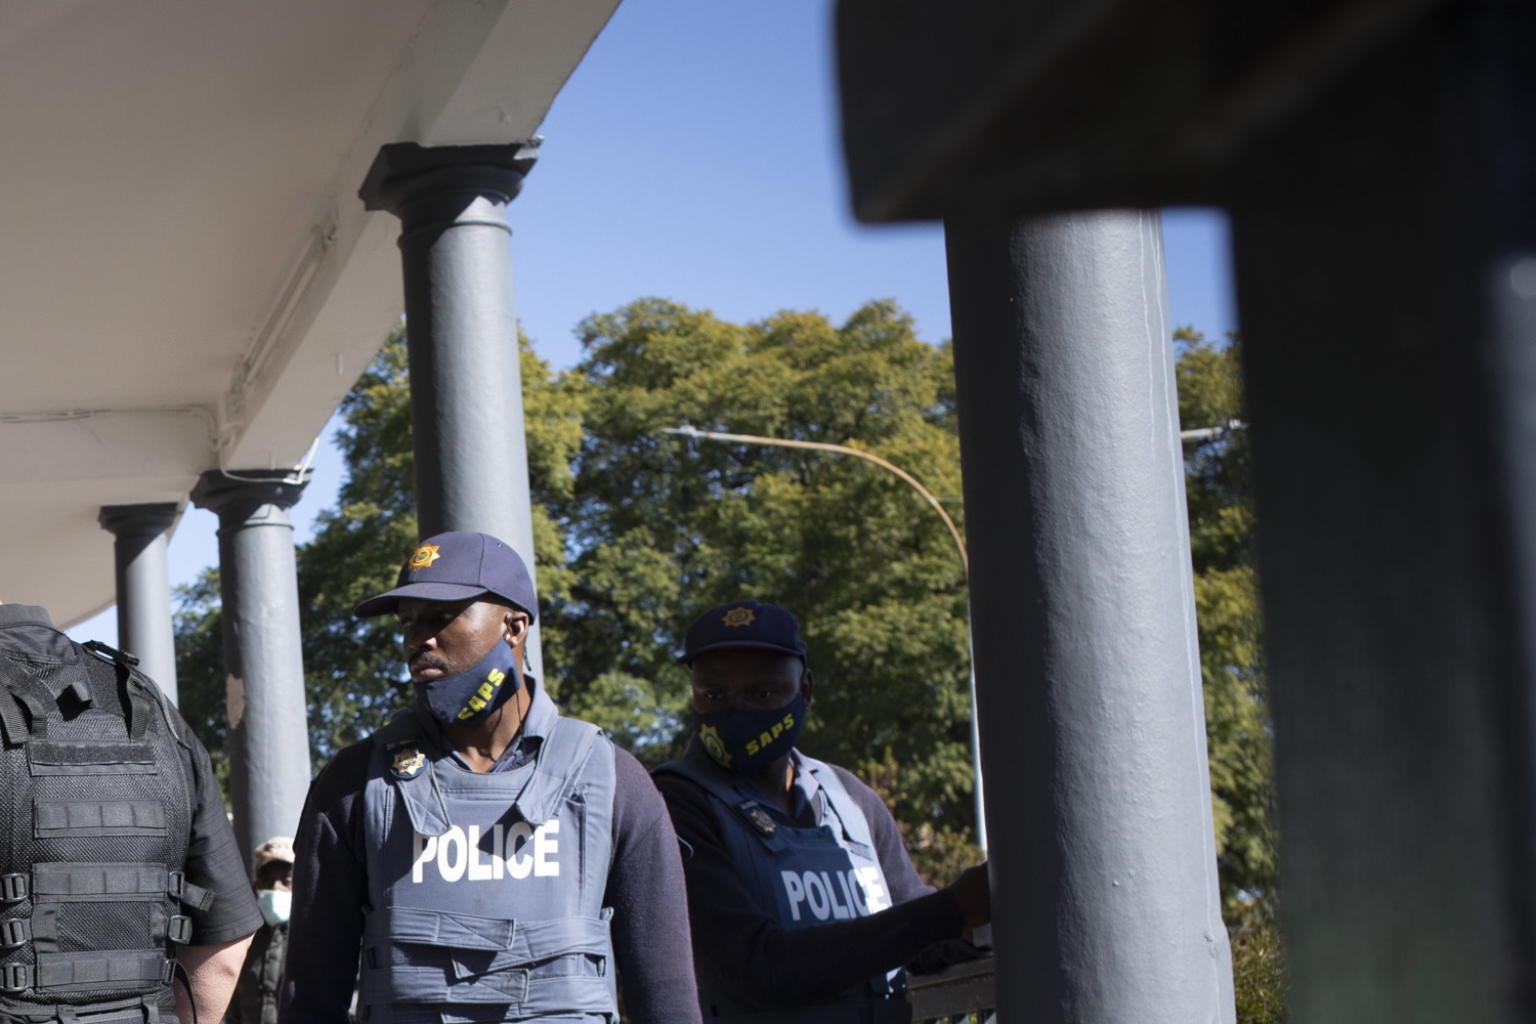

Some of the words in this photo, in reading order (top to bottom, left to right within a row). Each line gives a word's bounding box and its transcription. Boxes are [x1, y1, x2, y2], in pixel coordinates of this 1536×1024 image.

[745, 713, 795, 757] SAPS
[412, 819, 560, 884] POLICE
[781, 866, 893, 922] POLICE
